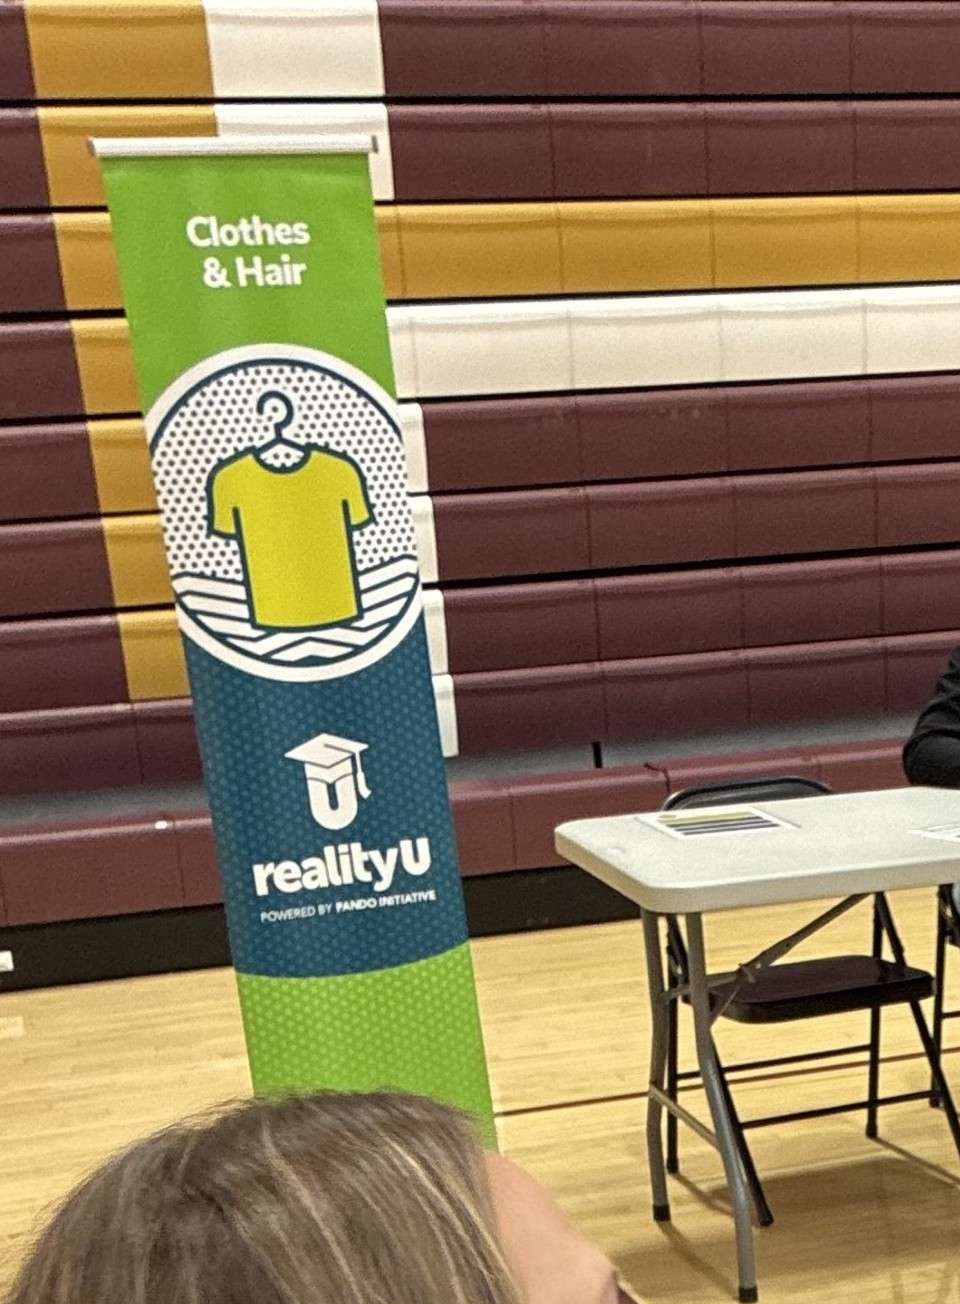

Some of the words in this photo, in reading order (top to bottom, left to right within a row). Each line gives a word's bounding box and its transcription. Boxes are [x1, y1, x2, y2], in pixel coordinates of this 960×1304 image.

[186, 215, 311, 248] Clothes
[203, 260, 230, 288] &
[236, 256, 307, 287] Hair
[252, 837, 432, 897] realityU
[260, 905, 315, 923] POWERED
[318, 904, 332, 916] BY
[335, 898, 376, 914] PANDO
[379, 890, 437, 908] INITIATIVE
